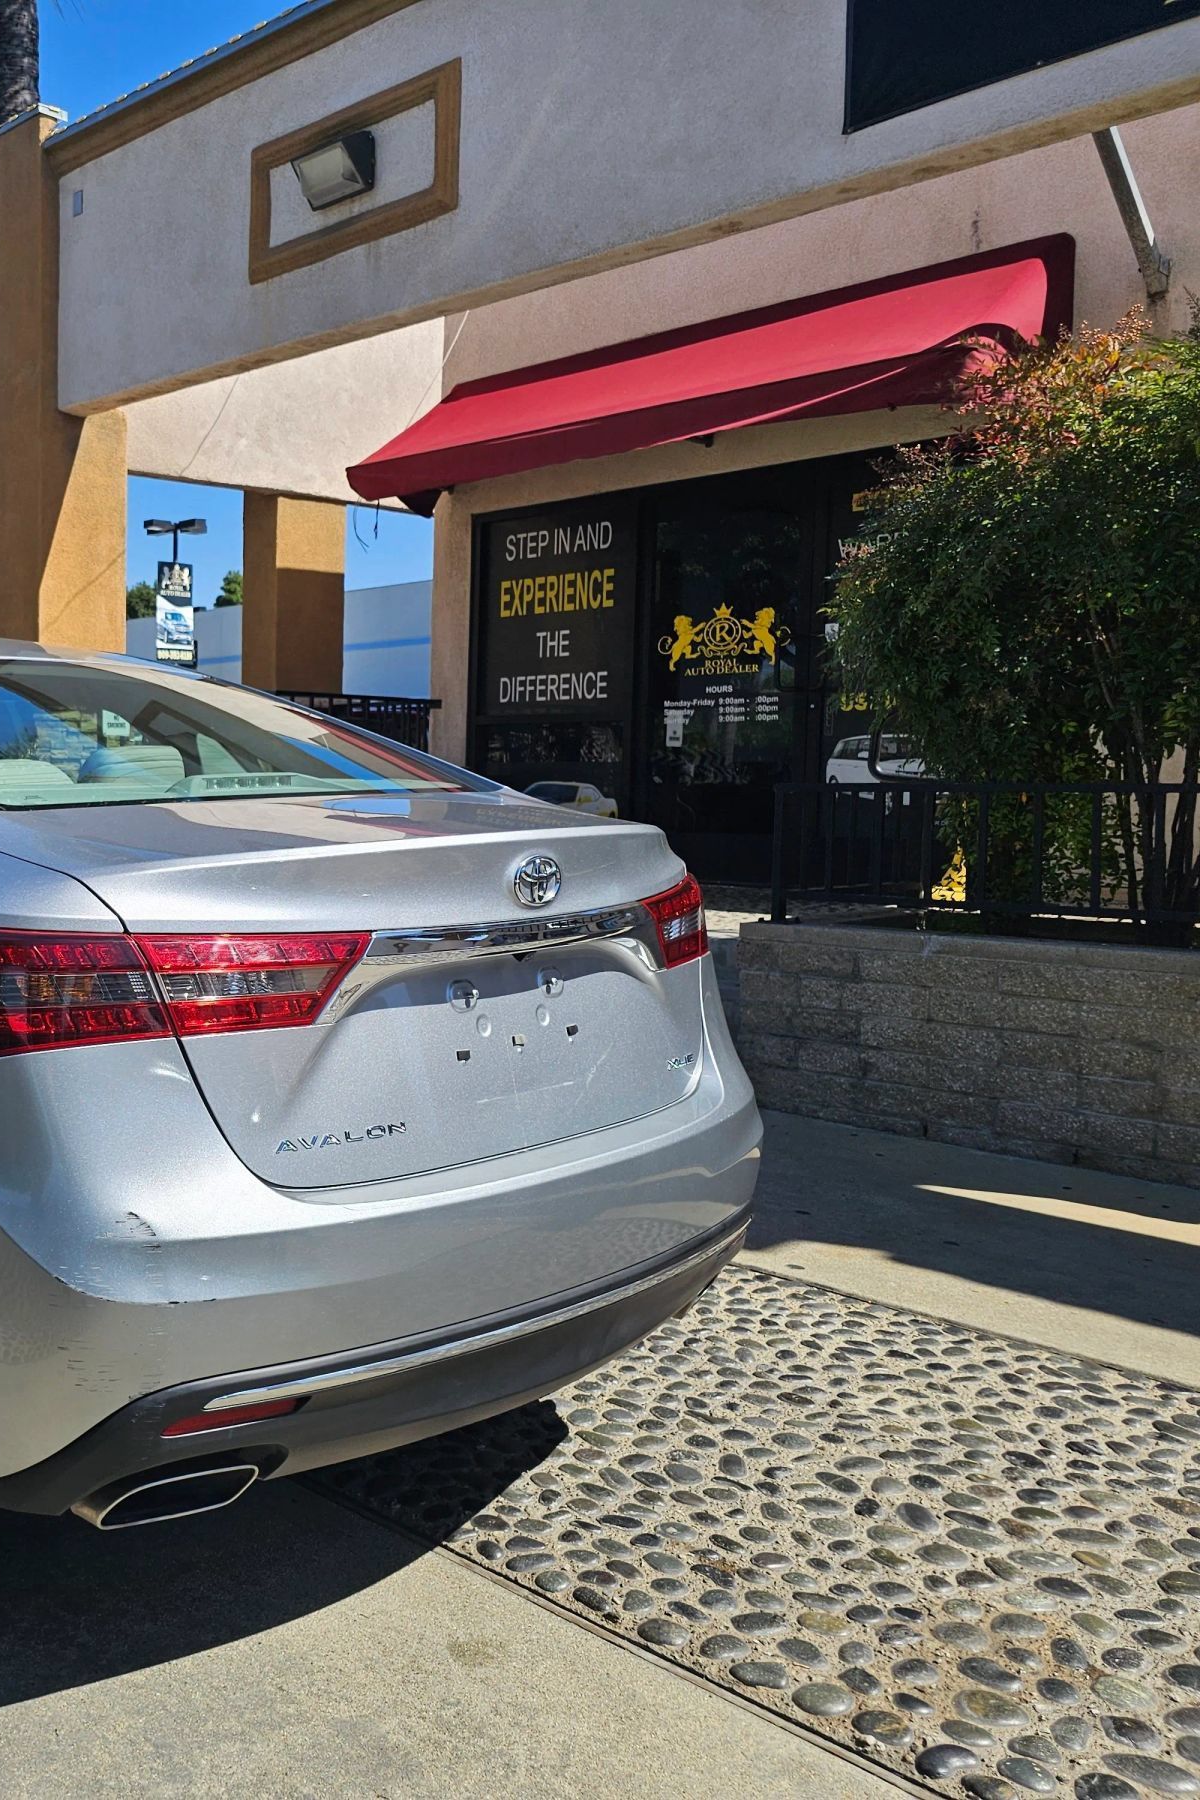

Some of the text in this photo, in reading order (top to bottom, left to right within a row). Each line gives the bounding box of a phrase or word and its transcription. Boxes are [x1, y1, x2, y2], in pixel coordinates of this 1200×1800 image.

[505, 521, 613, 561] STEP IN AND
[500, 568, 615, 618] EXPERIENCE
[536, 630, 570, 658] THE
[705, 658, 739, 669] ROYAL
[684, 664, 760, 676] AUTO DEALER
[500, 671, 608, 703] DIFFERENCE
[705, 685, 733, 693] HOURS
[663, 698, 716, 708] Monday-Friday
[718, 697, 745, 705] 9:00am
[718, 706, 745, 714] 9:00am
[718, 714, 745, 723] 9:00am
[275, 1121, 407, 1155] AVALON
